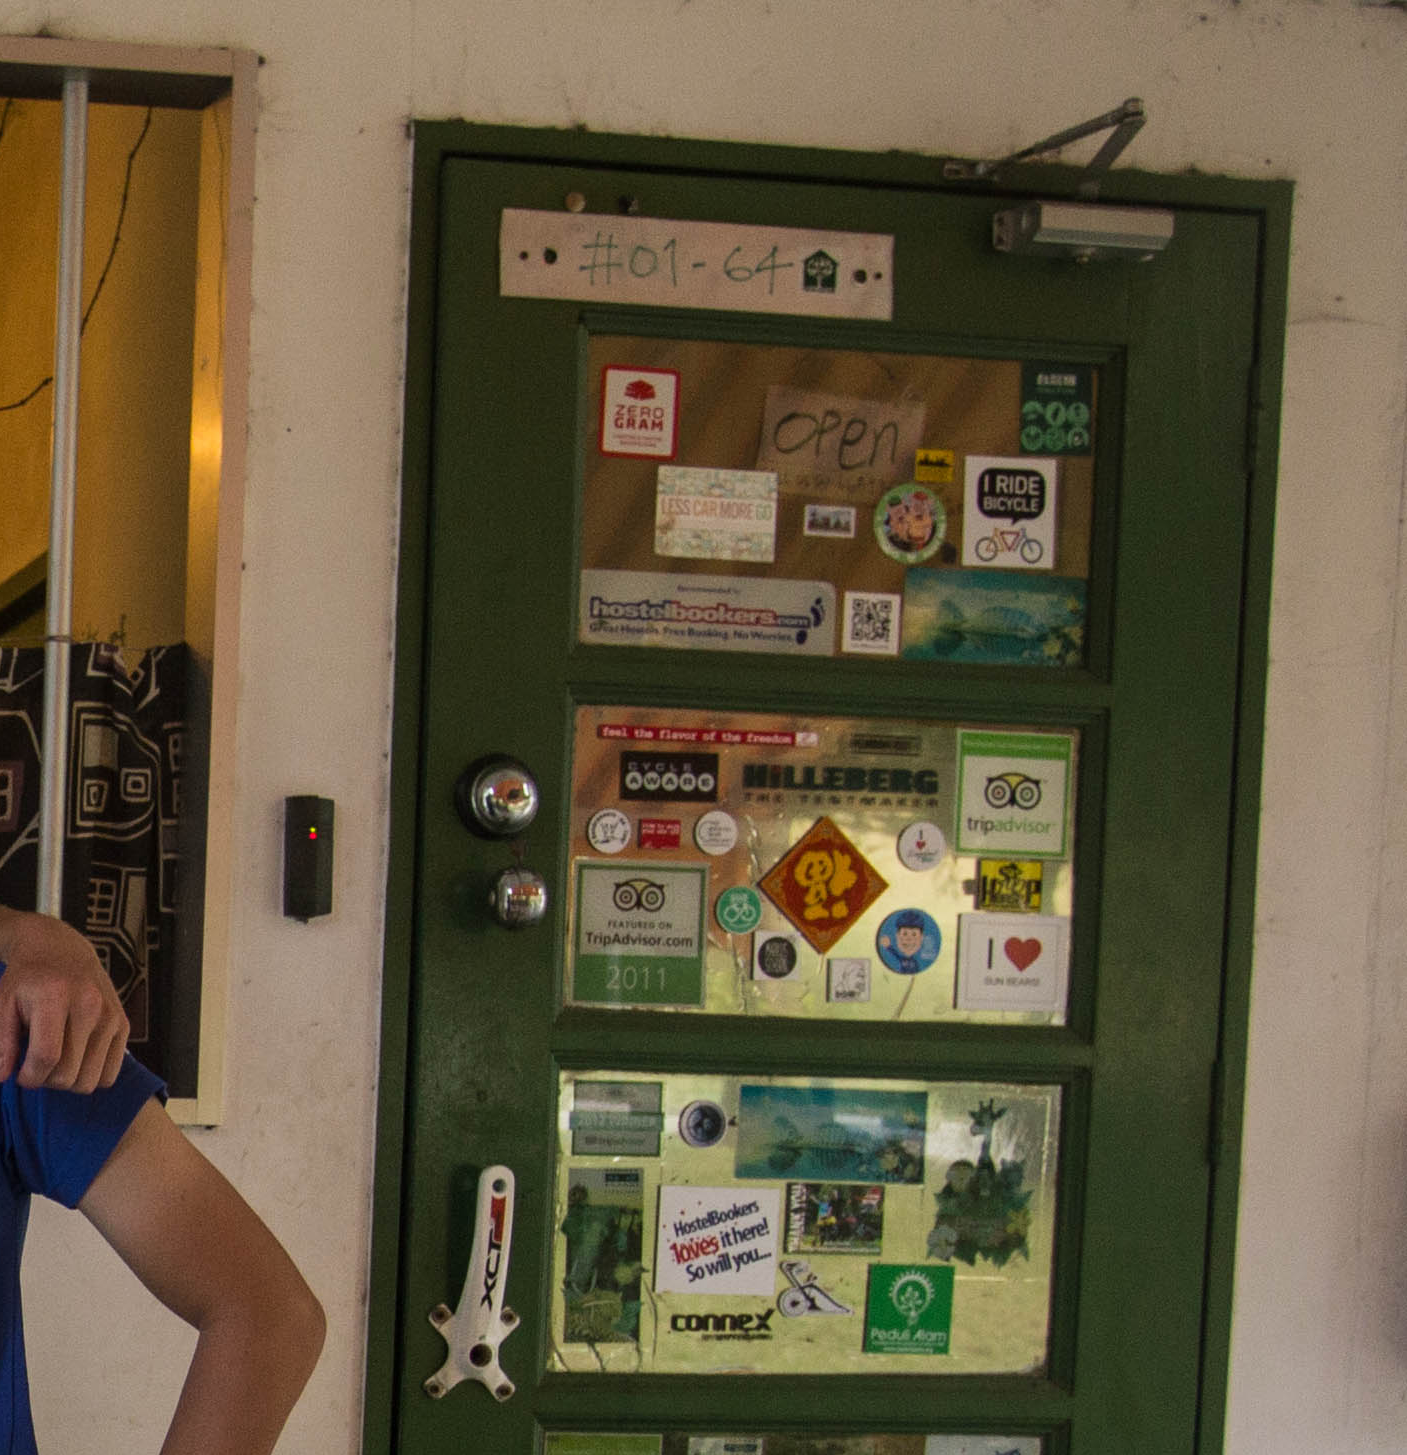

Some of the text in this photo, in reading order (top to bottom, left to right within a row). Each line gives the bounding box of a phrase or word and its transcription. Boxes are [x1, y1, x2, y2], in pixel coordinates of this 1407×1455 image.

[614, 404, 665, 419] ZERO
[613, 417, 664, 432] GRAM
[996, 476, 1040, 495] RIDE
[661, 500, 691, 516] LESS
[693, 501, 718, 517] CAR
[719, 502, 754, 521] MORE
[982, 496, 1039, 513] BICYCLE
[589, 595, 811, 630] hostelbookers.com
[602, 727, 628, 738] feel
[635, 728, 654, 739] the
[659, 729, 698, 742] flavor
[702, 730, 717, 741] of
[722, 731, 742, 744] the
[746, 732, 793, 745] freedom
[967, 816, 1053, 836] tripadvisor
[607, 920, 673, 930] FEATURED ON
[586, 931, 693, 949] TripAdvisor.com
[605, 965, 668, 991] 2011
[673, 1201, 760, 1238] HostelBookers
[669, 1218, 770, 1265] loves it here!
[686, 1263, 705, 1284] So
[704, 1255, 732, 1277] will
[671, 1309, 776, 1333] connex
